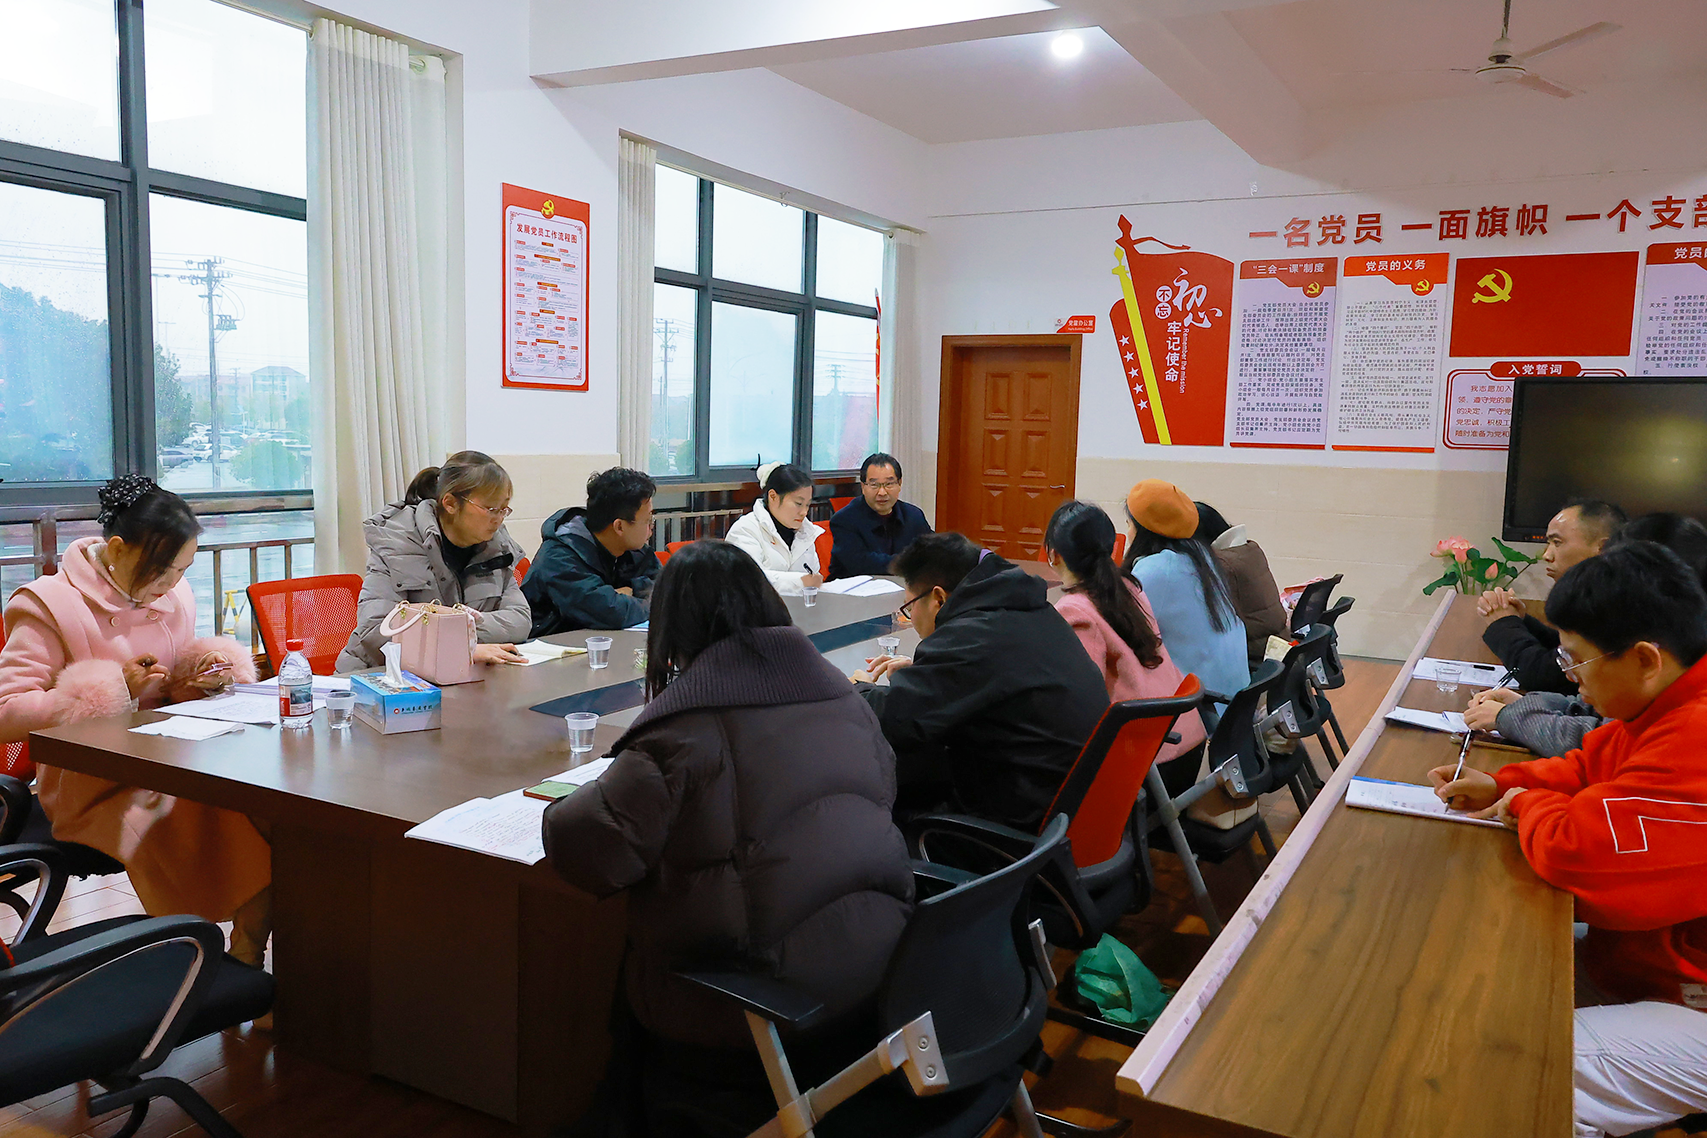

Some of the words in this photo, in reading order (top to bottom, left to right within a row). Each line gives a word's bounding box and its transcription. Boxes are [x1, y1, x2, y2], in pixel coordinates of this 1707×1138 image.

[516, 223, 578, 244] 发展党员工作流程图
[1248, 212, 1384, 249] 一名党员
[1401, 203, 1550, 242] 一面旗帜
[1365, 259, 1426, 272] 党员的义务
[1674, 246, 1707, 259] 党员
[1156, 286, 1172, 319] 不忘
[1172, 267, 1223, 328] 初心
[1165, 321, 1182, 382] 牢记使命
[1508, 364, 1563, 375] 入党誓词
